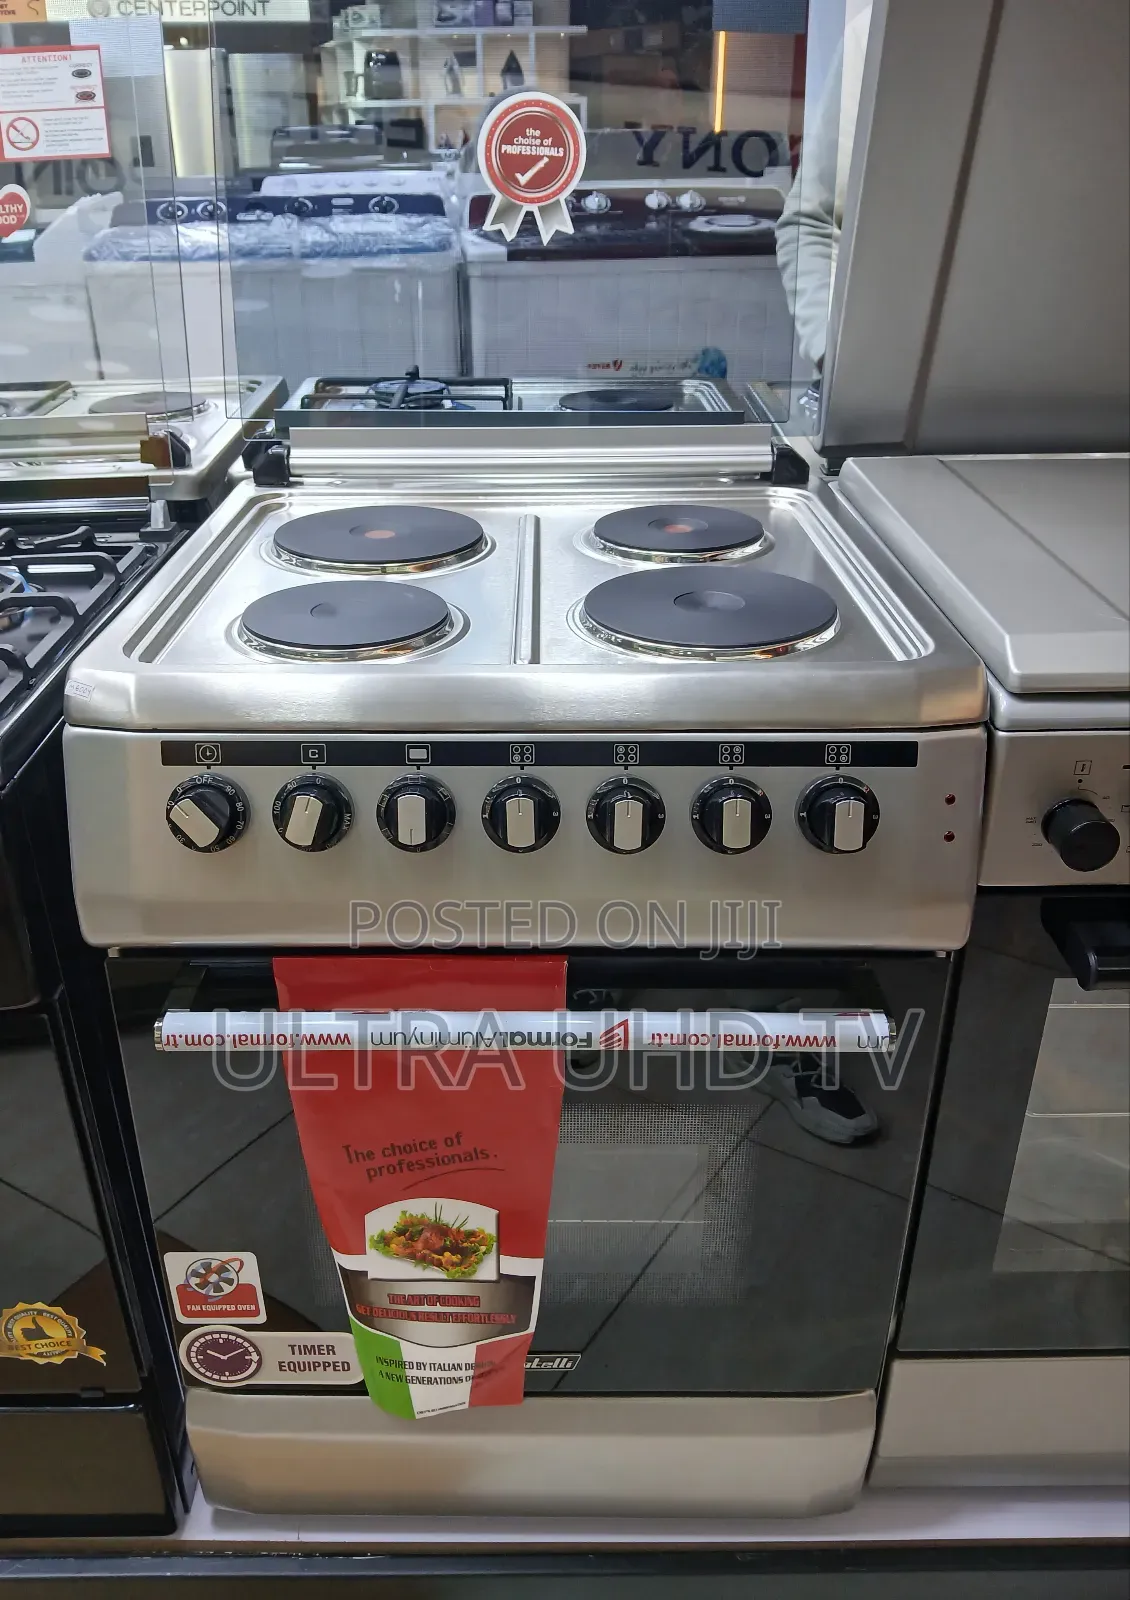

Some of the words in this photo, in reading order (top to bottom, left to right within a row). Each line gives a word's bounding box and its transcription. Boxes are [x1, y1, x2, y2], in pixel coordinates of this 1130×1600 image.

[117, 0, 271, 17] CENTERPOINT
[21, 54, 72, 63] ATTENTION!
[526, 128, 541, 137] the
[543, 137, 553, 146] of
[501, 144, 564, 157] PROFESSIONALS
[196, 776, 214, 785] OFF
[315, 777, 322, 785] 0
[515, 776, 522, 784] 0
[622, 777, 629, 785] 0
[225, 785, 236, 796] 90
[235, 802, 245, 812] 80
[273, 800, 282, 815] 100
[235, 820, 245, 830] 70
[164, 1033, 352, 1048] www.formal.com.tr
[648, 1033, 837, 1049] www.formal.com.tr
[342, 1144, 376, 1164] The
[381, 1137, 438, 1159] choice
[444, 1131, 464, 1147] of
[366, 1147, 498, 1184] professionals.
[387, 1293, 406, 1305] THE
[407, 1294, 426, 1306] ART
[426, 1294, 439, 1306] OF
[439, 1295, 480, 1307] COOKING
[355, 1303, 371, 1316] GET
[372, 1305, 417, 1321] DELICIOUS
[7, 1343, 32, 1351] BEST
[34, 1340, 73, 1349] CHOICE
[288, 1344, 336, 1356] TIMER
[278, 1360, 351, 1372] EQUIPPED
[375, 1355, 415, 1370] INSPIRED
[416, 1362, 427, 1371] BY
[429, 1362, 462, 1371] ITALIAN
[385, 1371, 404, 1383] NEW
[405, 1375, 464, 1386] GENERATIONS
